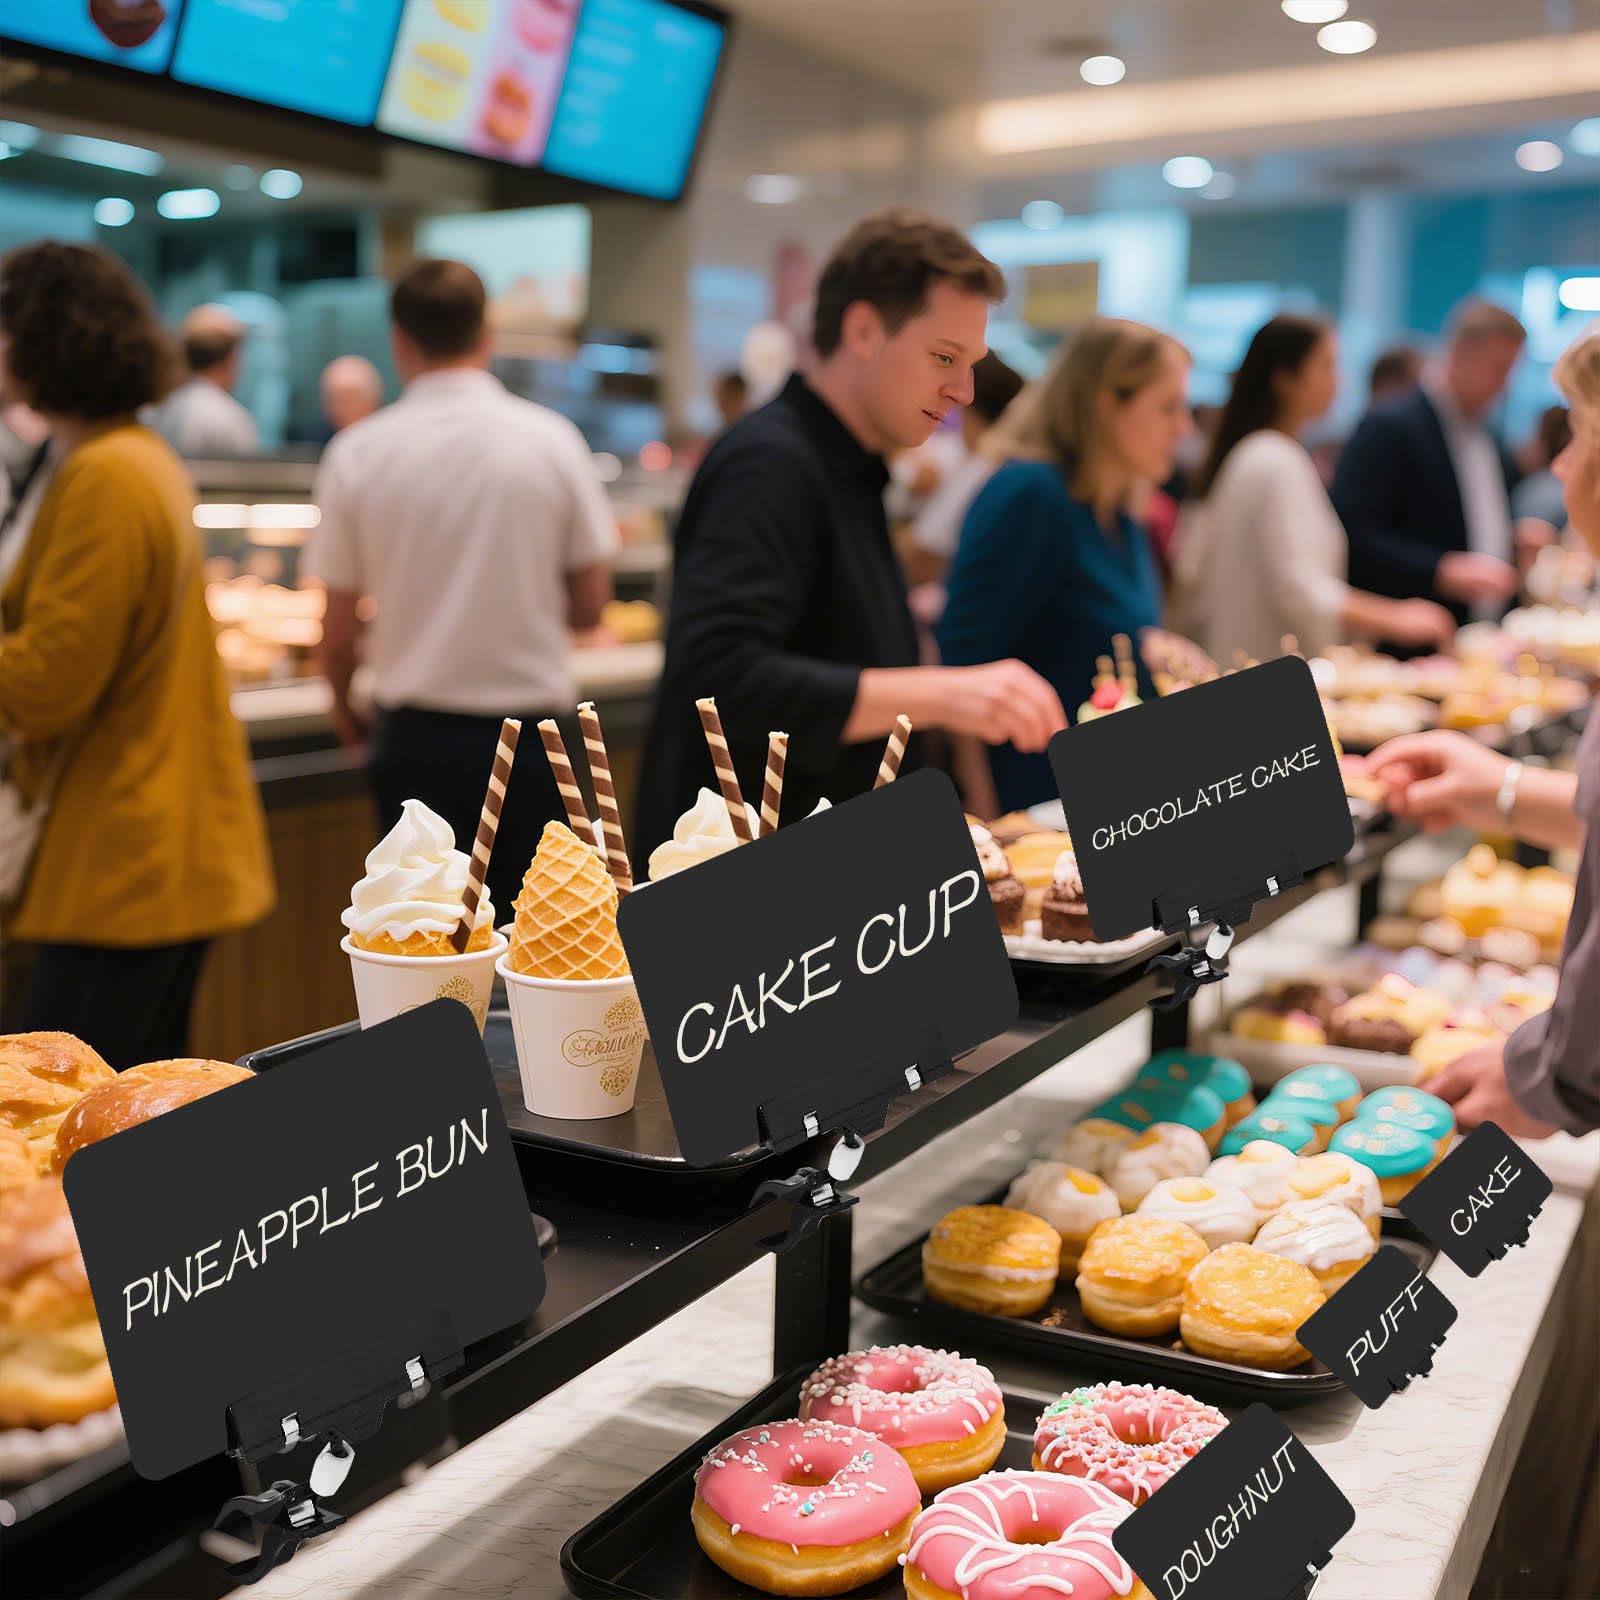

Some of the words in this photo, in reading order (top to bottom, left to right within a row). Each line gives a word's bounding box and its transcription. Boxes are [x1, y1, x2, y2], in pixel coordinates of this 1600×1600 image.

[1092, 773, 1246, 851] CHOCOLATE
[1251, 743, 1321, 789] CAKE
[676, 936, 841, 1064] CAKE
[856, 868, 982, 975] CUP
[122, 1161, 384, 1332] PINEAPPLE
[396, 1107, 491, 1199] BUN
[1449, 1154, 1523, 1237] CAKE
[1345, 1270, 1428, 1377] PUFF
[1162, 1435, 1296, 1600] DOUGHNUT
